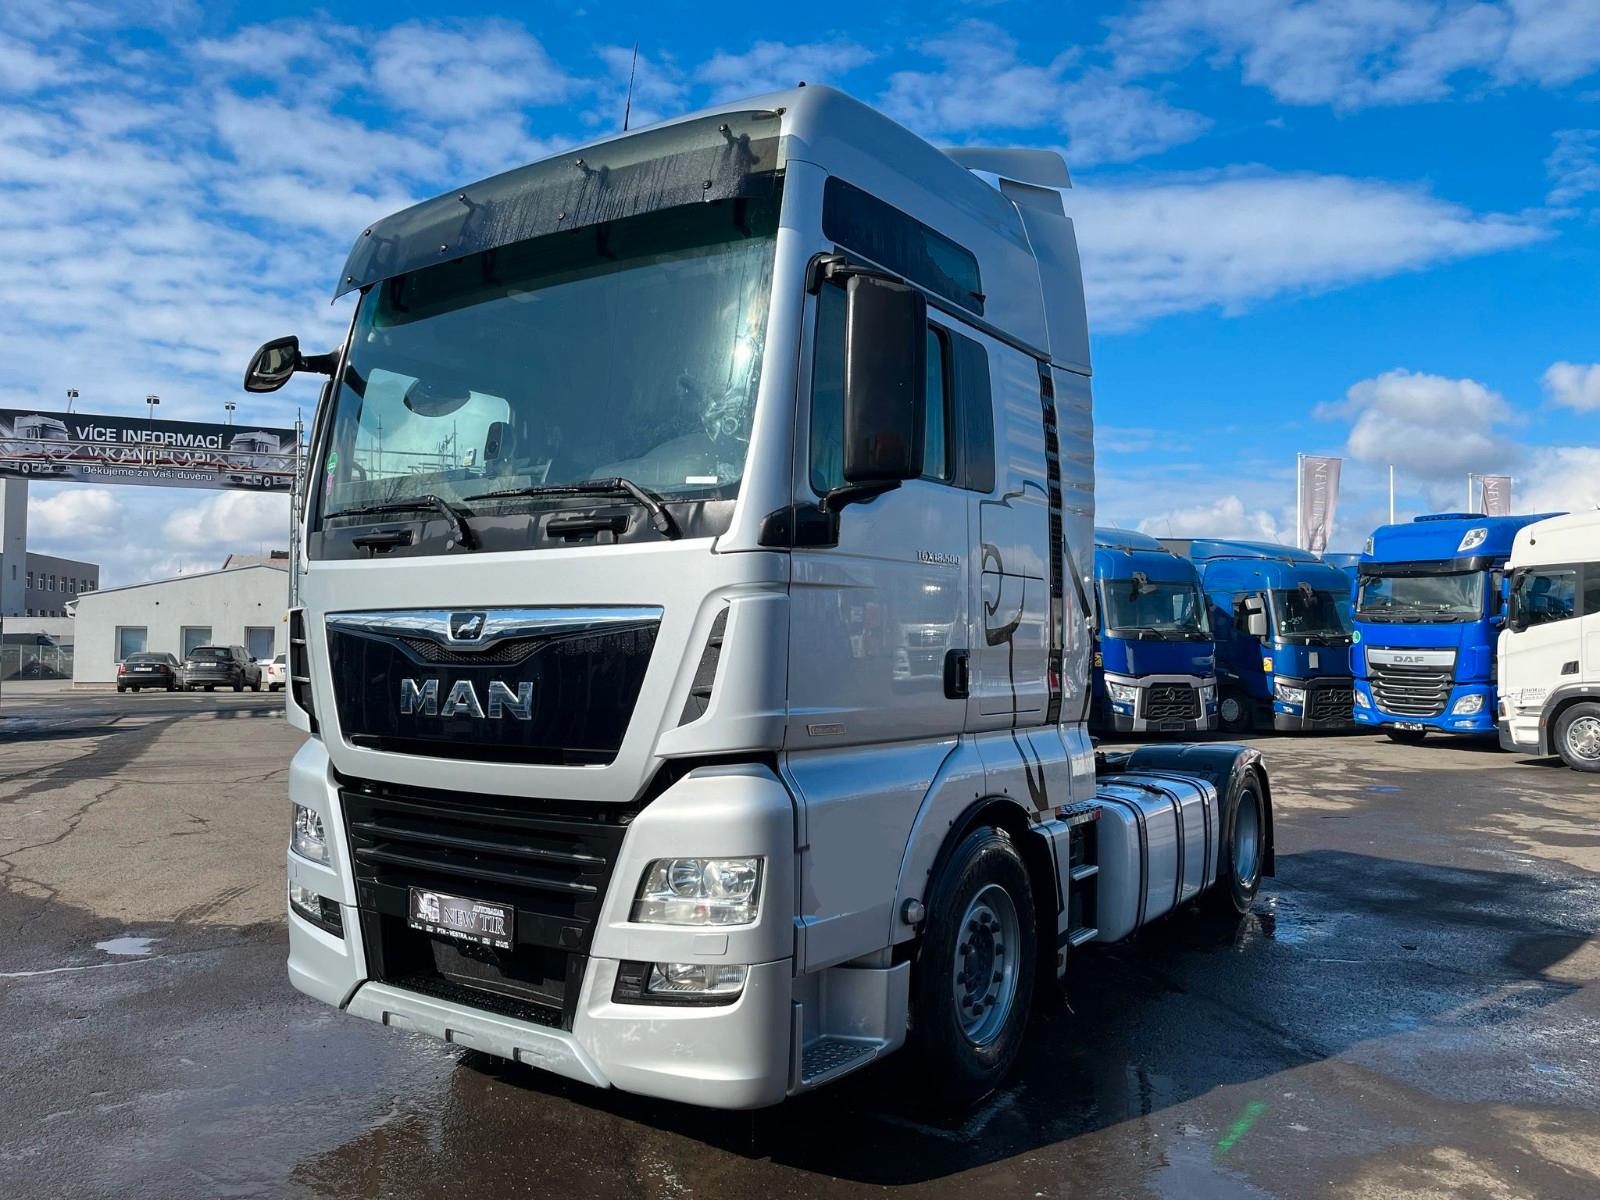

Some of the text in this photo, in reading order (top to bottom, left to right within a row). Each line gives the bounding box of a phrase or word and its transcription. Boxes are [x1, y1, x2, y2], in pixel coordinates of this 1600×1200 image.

[76, 424, 223, 449] VÍCE INFORMACÍ
[1393, 655, 1425, 663] DAF
[400, 678, 534, 721] MAN
[443, 905, 506, 936] NEW TIR
